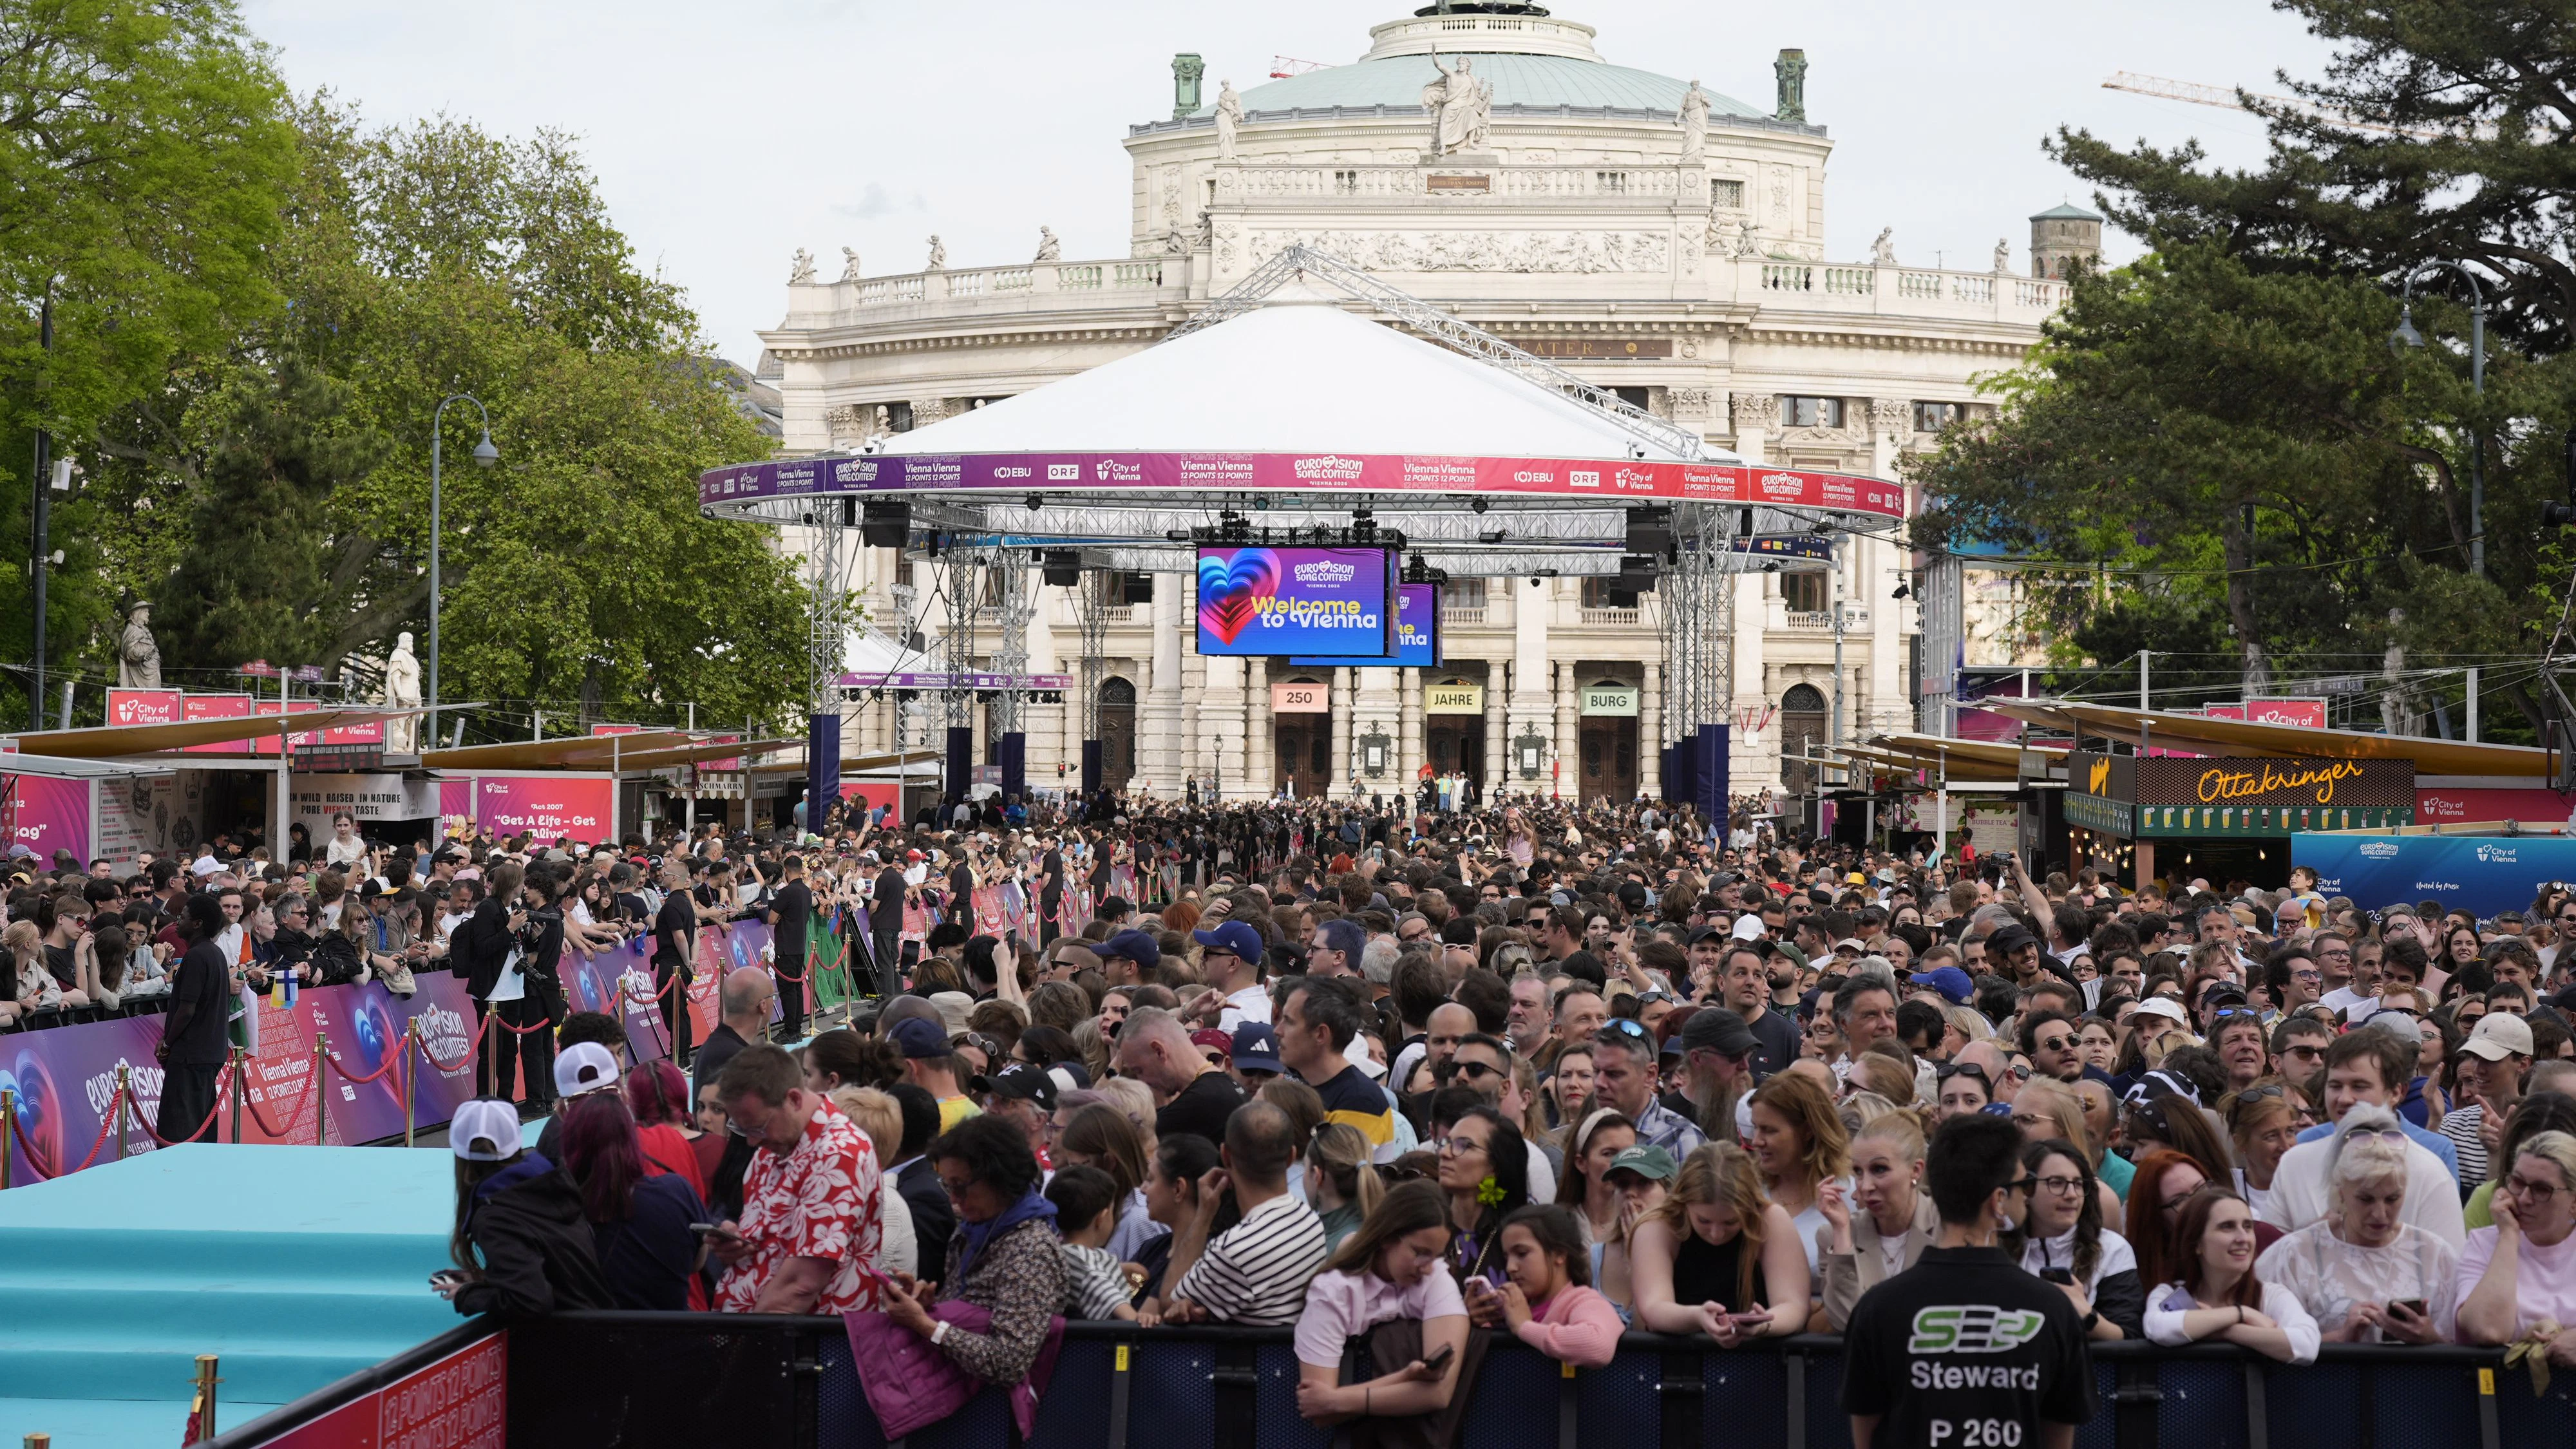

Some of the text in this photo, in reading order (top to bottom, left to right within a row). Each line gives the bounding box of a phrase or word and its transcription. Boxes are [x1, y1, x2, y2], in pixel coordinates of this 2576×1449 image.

[905, 463, 961, 473] Vienna Vienna
[1113, 464, 1129, 473] City
[1180, 461, 1253, 471] Vienna Vienna
[1404, 463, 1475, 474] Vienna Vienna
[777, 469, 814, 479] Vienna Vienna
[1012, 468, 1031, 477] EBU
[1629, 472, 1643, 482] City
[1533, 473, 1553, 483] EBU
[1573, 475, 1597, 483] ORF
[1685, 473, 1735, 484] Vienna Vienna
[1630, 482, 1653, 490] Vienna
[1296, 573, 1353, 582] SONG CONTEST
[1251, 596, 1361, 614] Welcome
[1262, 610, 1377, 629] to Vienna
[1286, 692, 1312, 704] 250
[1434, 694, 1473, 706] JAHRE
[1591, 695, 1627, 707] BURG
[138, 704, 169, 714] City of
[138, 714, 169, 723] Vienna
[2301, 716, 2313, 726] of
[2198, 760, 2363, 803] Ottakringer
[301, 793, 401, 803] WILD RAISED IN NATURE
[301, 805, 320, 814] PURE
[2438, 801, 2453, 810] City
[526, 815, 535, 825] A
[538, 815, 561, 827] Life
[573, 815, 596, 826] Get
[2492, 848, 2506, 857] City
[2317, 878, 2331, 887] City
[2416, 881, 2434, 890] United
[2436, 881, 2443, 891] by
[257, 1055, 310, 1082] Vienna Vienna
[266, 1079, 298, 1100] 12 POINTS 12
[343, 1088, 354, 1099] ORF
[1911, 1359, 2040, 1391] Steward
[399, 1370, 447, 1430] POINTS
[460, 1343, 502, 1398] POINTS
[1930, 1418, 2022, 1448] P 260
